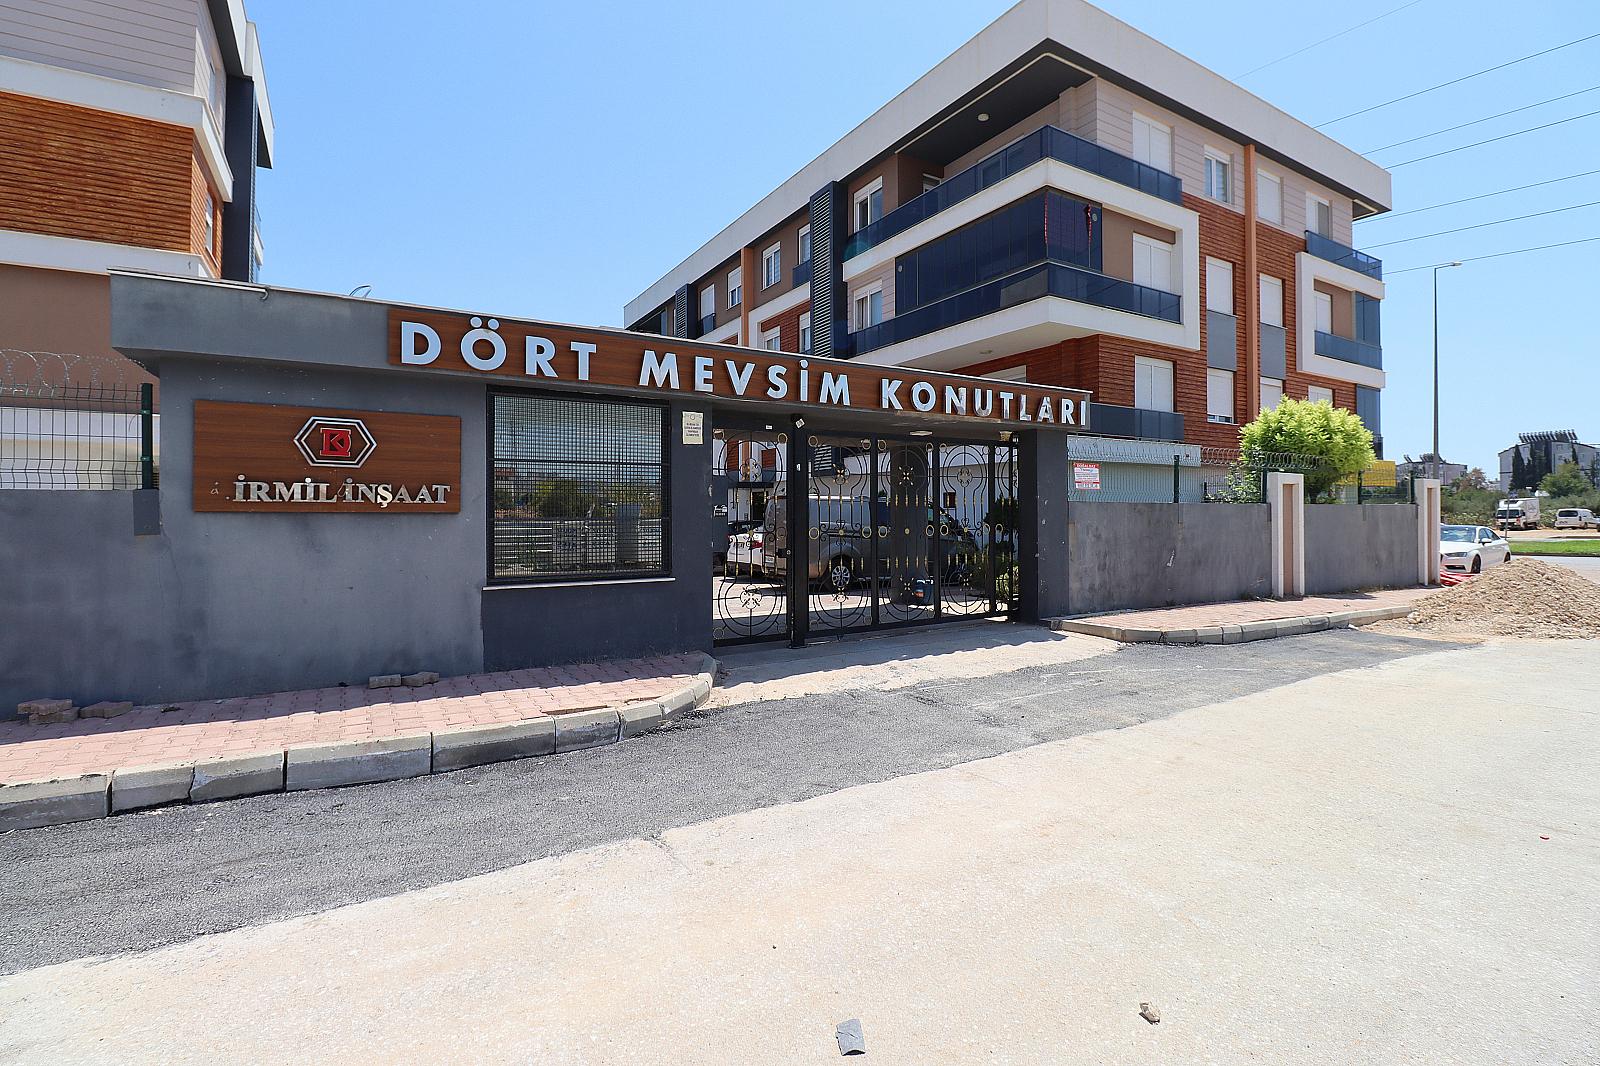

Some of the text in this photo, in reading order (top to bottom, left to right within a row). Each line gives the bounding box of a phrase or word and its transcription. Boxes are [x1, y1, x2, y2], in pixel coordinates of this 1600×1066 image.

[401, 316, 1087, 426] DÖRT MEVSİM KONUTLARI
[345, 477, 450, 508] İNŞAAT
